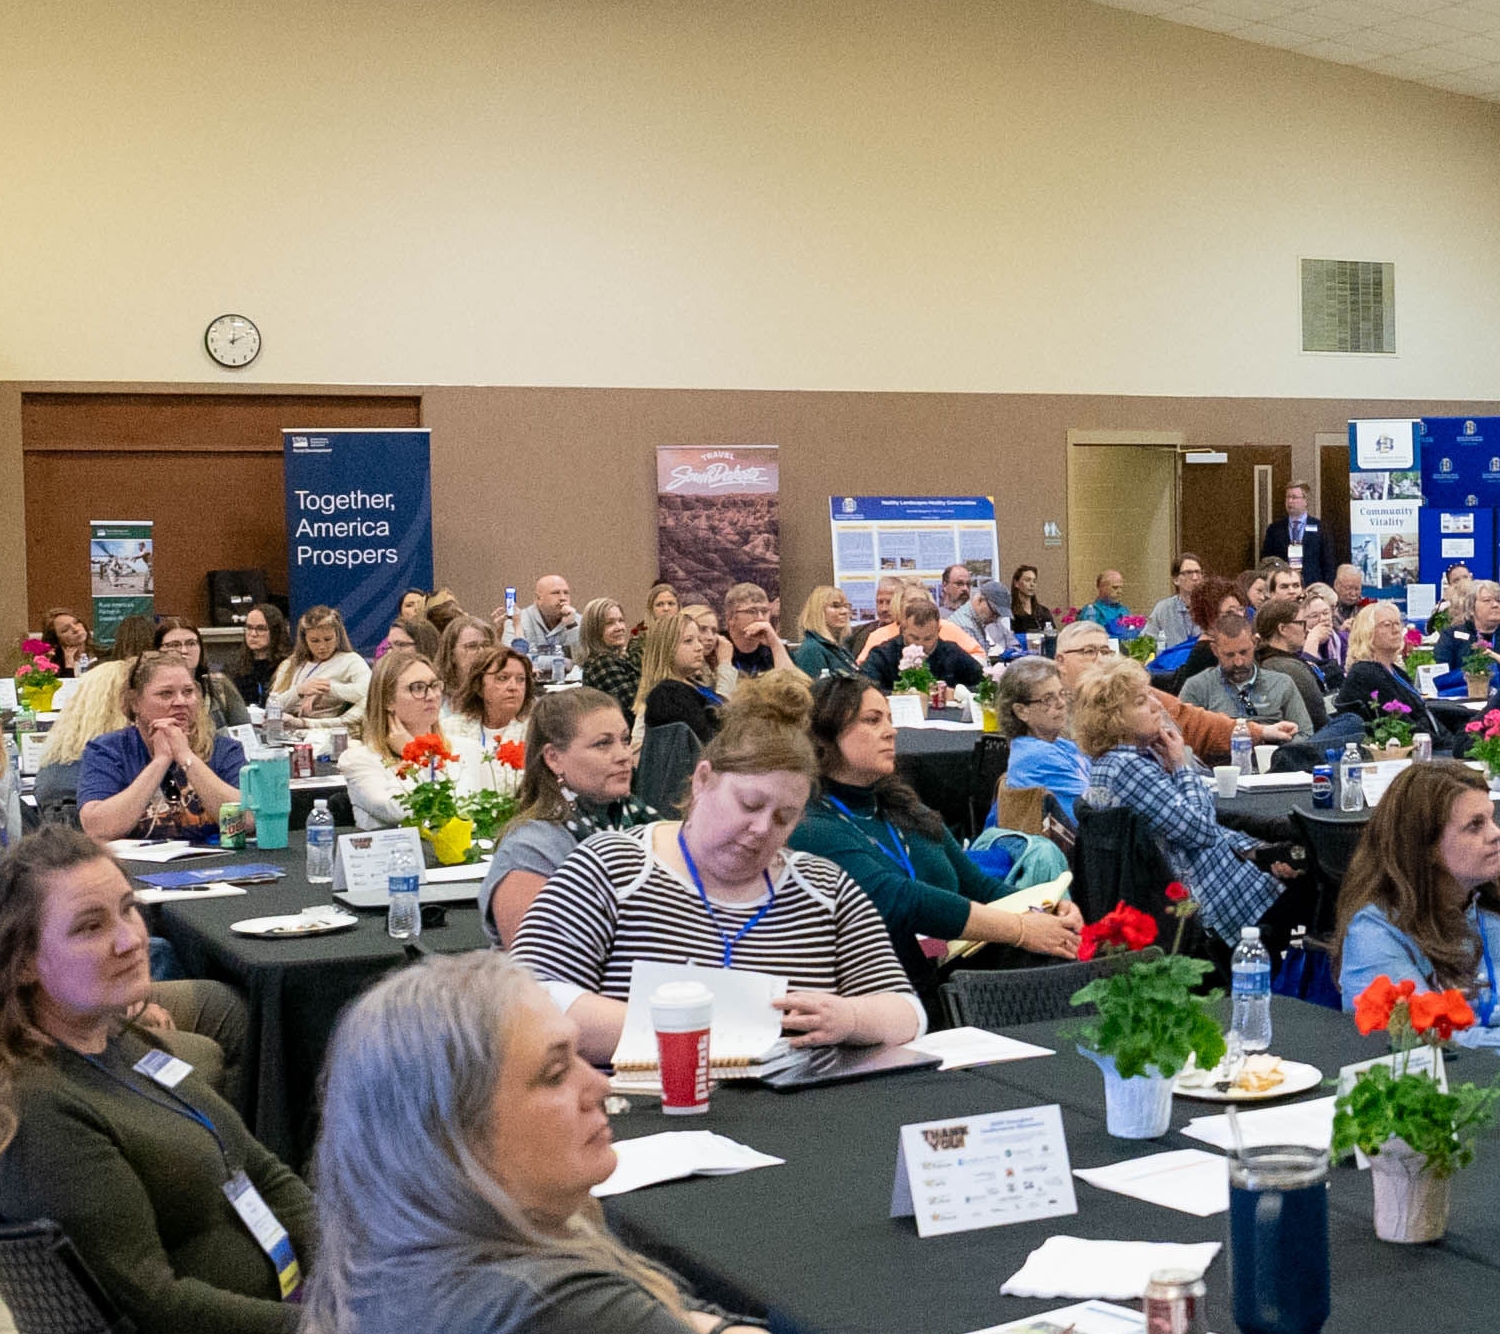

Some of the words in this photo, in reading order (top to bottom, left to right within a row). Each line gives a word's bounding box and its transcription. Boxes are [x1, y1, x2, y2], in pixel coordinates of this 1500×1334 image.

[700, 451, 735, 461] TRAVEL
[294, 490, 395, 515] Together,
[1360, 506, 1413, 516] Community
[296, 517, 390, 538] America
[1370, 517, 1404, 527] Vitality
[297, 546, 398, 569] Prospers
[921, 1125, 969, 1141] THANK
